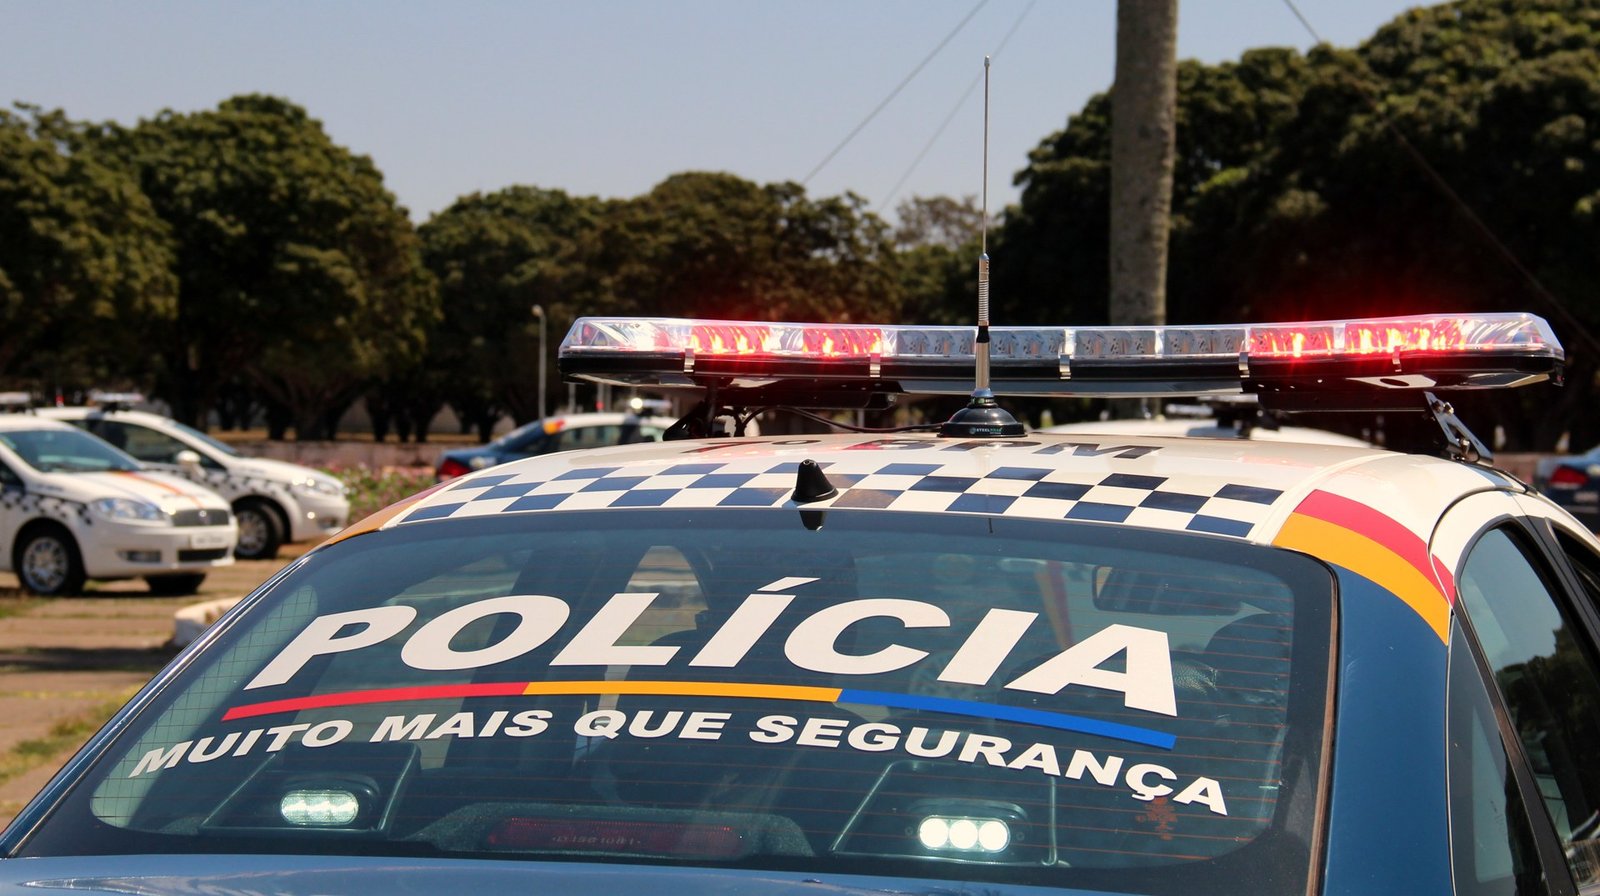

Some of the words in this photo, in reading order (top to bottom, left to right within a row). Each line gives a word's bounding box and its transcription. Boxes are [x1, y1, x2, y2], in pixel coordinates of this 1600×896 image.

[841, 439, 1164, 459] BPM
[244, 577, 1178, 717] POLÍCIA
[128, 719, 354, 778] MUITO
[370, 709, 553, 743] MAIS
[573, 710, 732, 740] QUE
[749, 715, 1228, 816] SEGURANÇA
